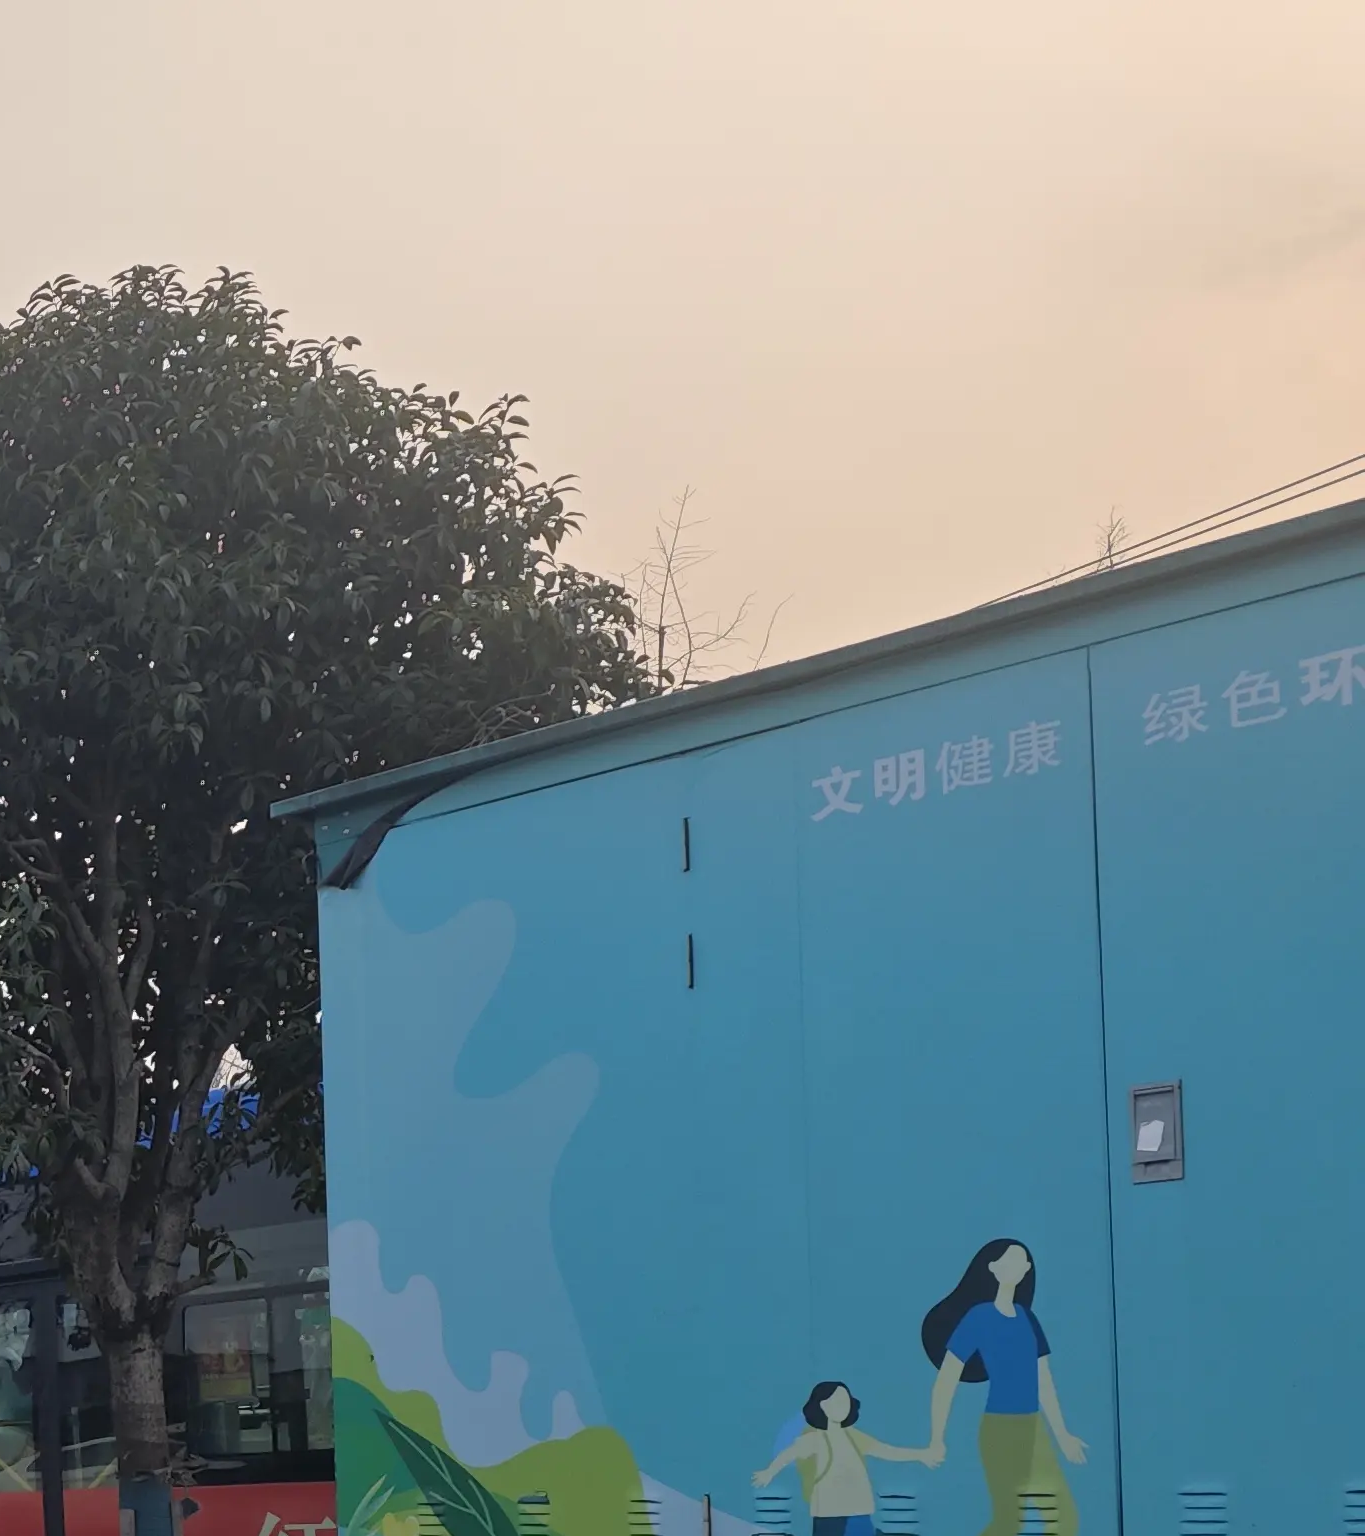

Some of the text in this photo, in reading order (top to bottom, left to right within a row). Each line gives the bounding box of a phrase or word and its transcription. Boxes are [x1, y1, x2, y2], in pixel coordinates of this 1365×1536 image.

[810, 643, 1365, 822] 文明健康 绿色环
